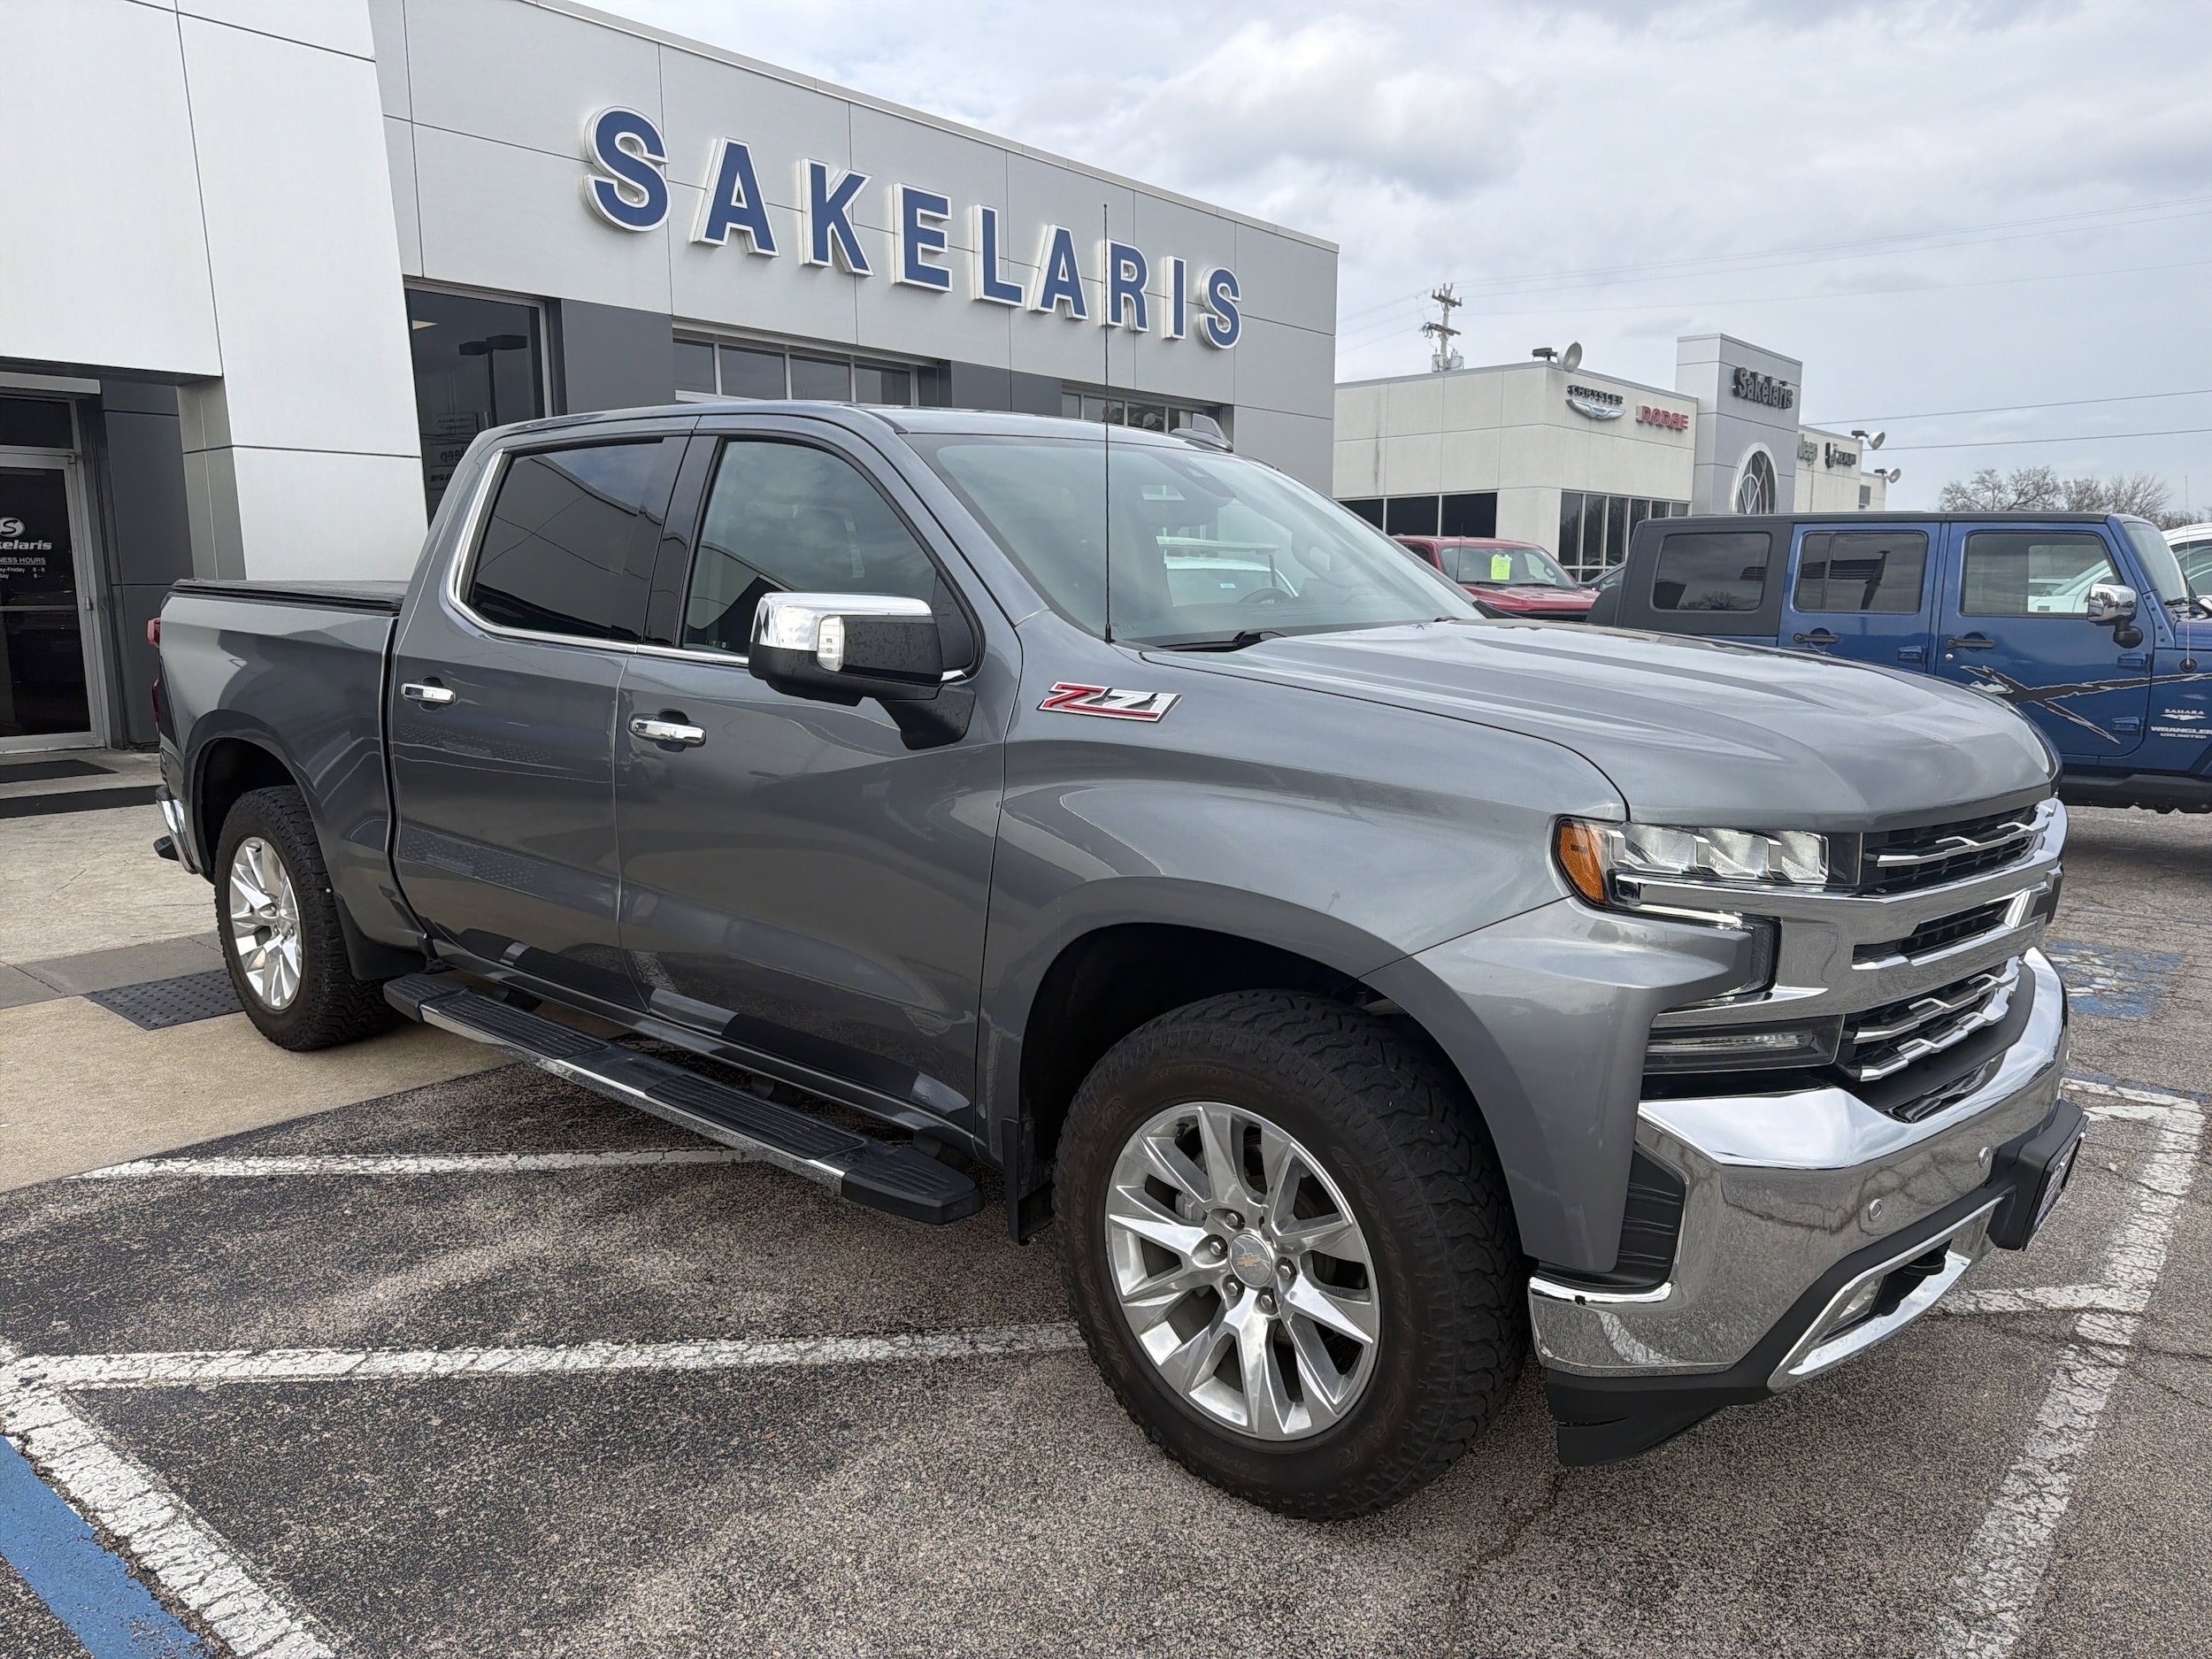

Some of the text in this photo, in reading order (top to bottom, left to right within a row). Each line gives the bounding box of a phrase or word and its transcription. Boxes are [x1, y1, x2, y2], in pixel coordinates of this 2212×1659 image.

[584, 105, 1242, 349] SAKELARIS
[1566, 385, 1624, 405] CHRYSLER
[1735, 367, 1793, 409] Sakelaris
[1640, 405, 1689, 430] DODGE
[1037, 681, 1182, 723] Z71
[2150, 726, 2212, 735] WRANGLER
